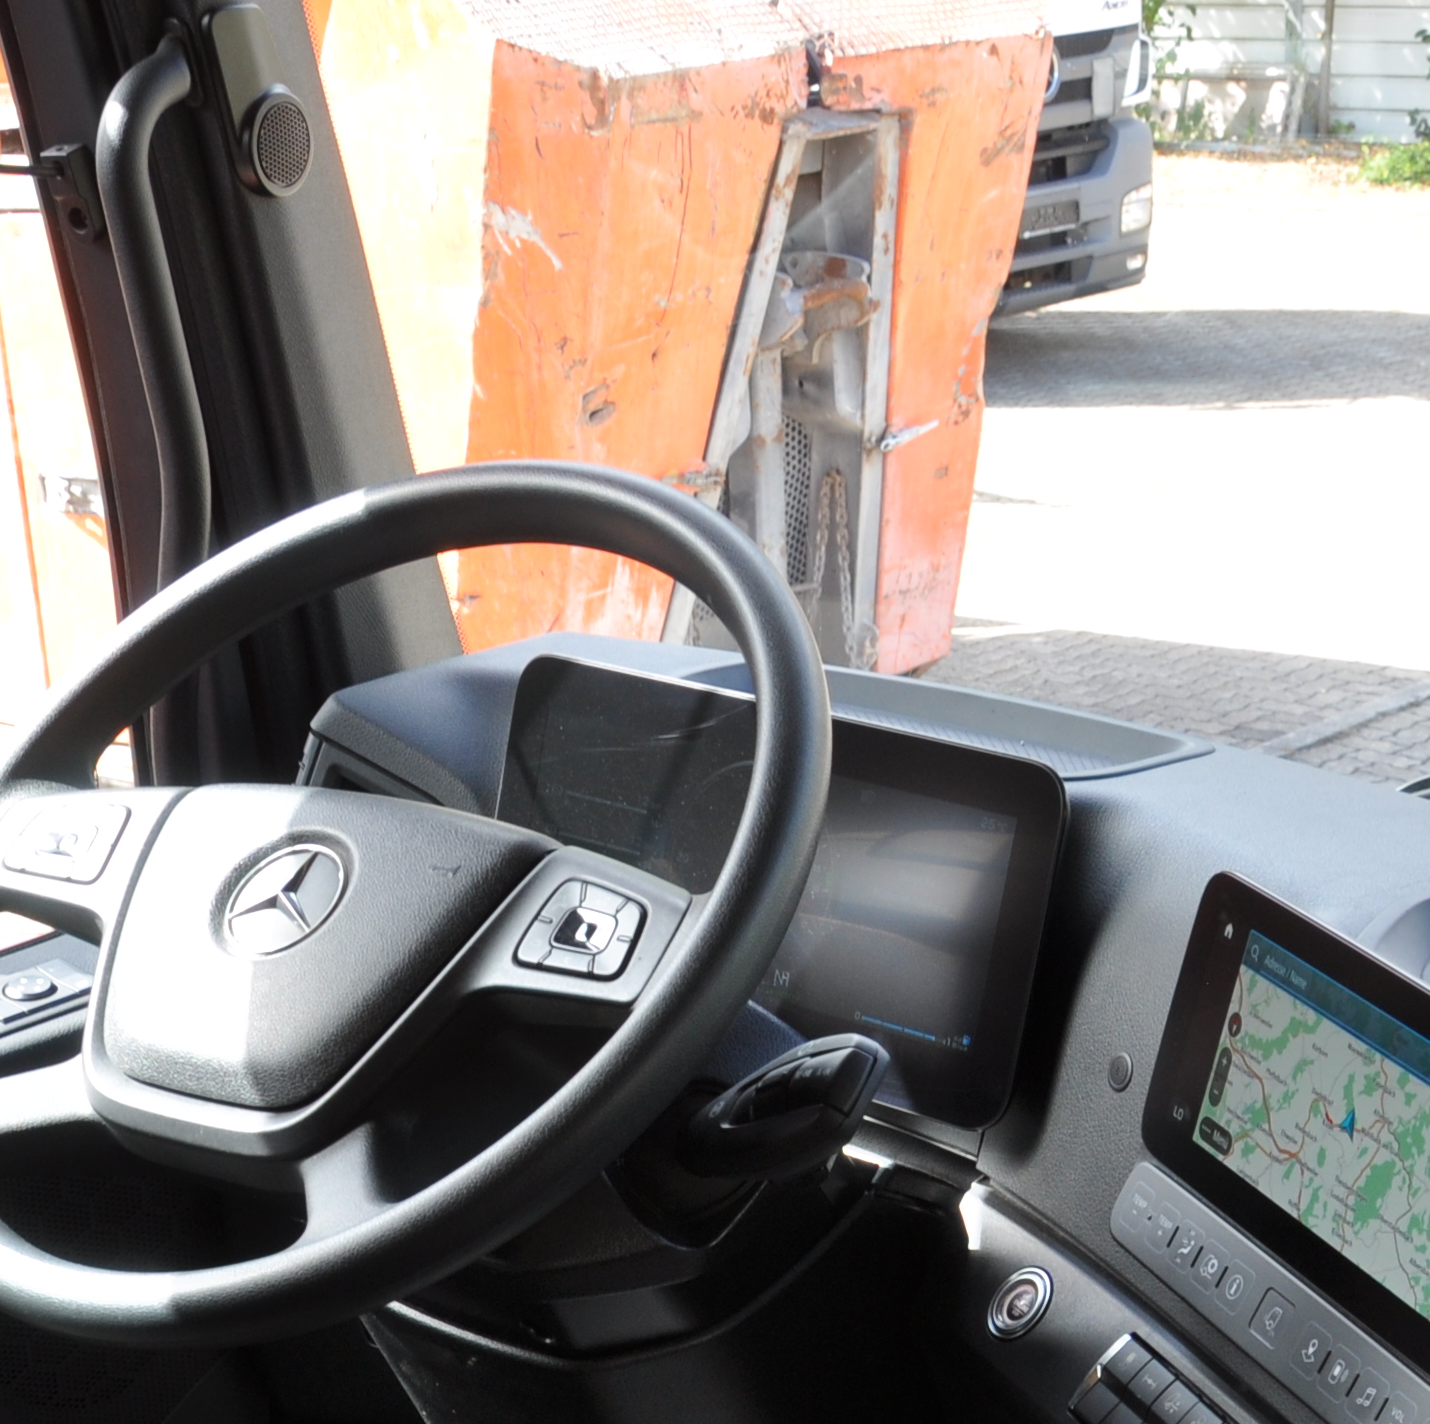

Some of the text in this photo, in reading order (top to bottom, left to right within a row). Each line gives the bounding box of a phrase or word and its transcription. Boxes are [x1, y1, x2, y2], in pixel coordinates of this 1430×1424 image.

[1264, 957, 1286, 978] Adresse
[1290, 969, 1308, 990] Name
[1173, 1104, 1185, 1121] LO
[1134, 1193, 1148, 1208] TEMP
[1159, 1214, 1173, 1229] TEMP
[1391, 1407, 1405, 1424] VOL
